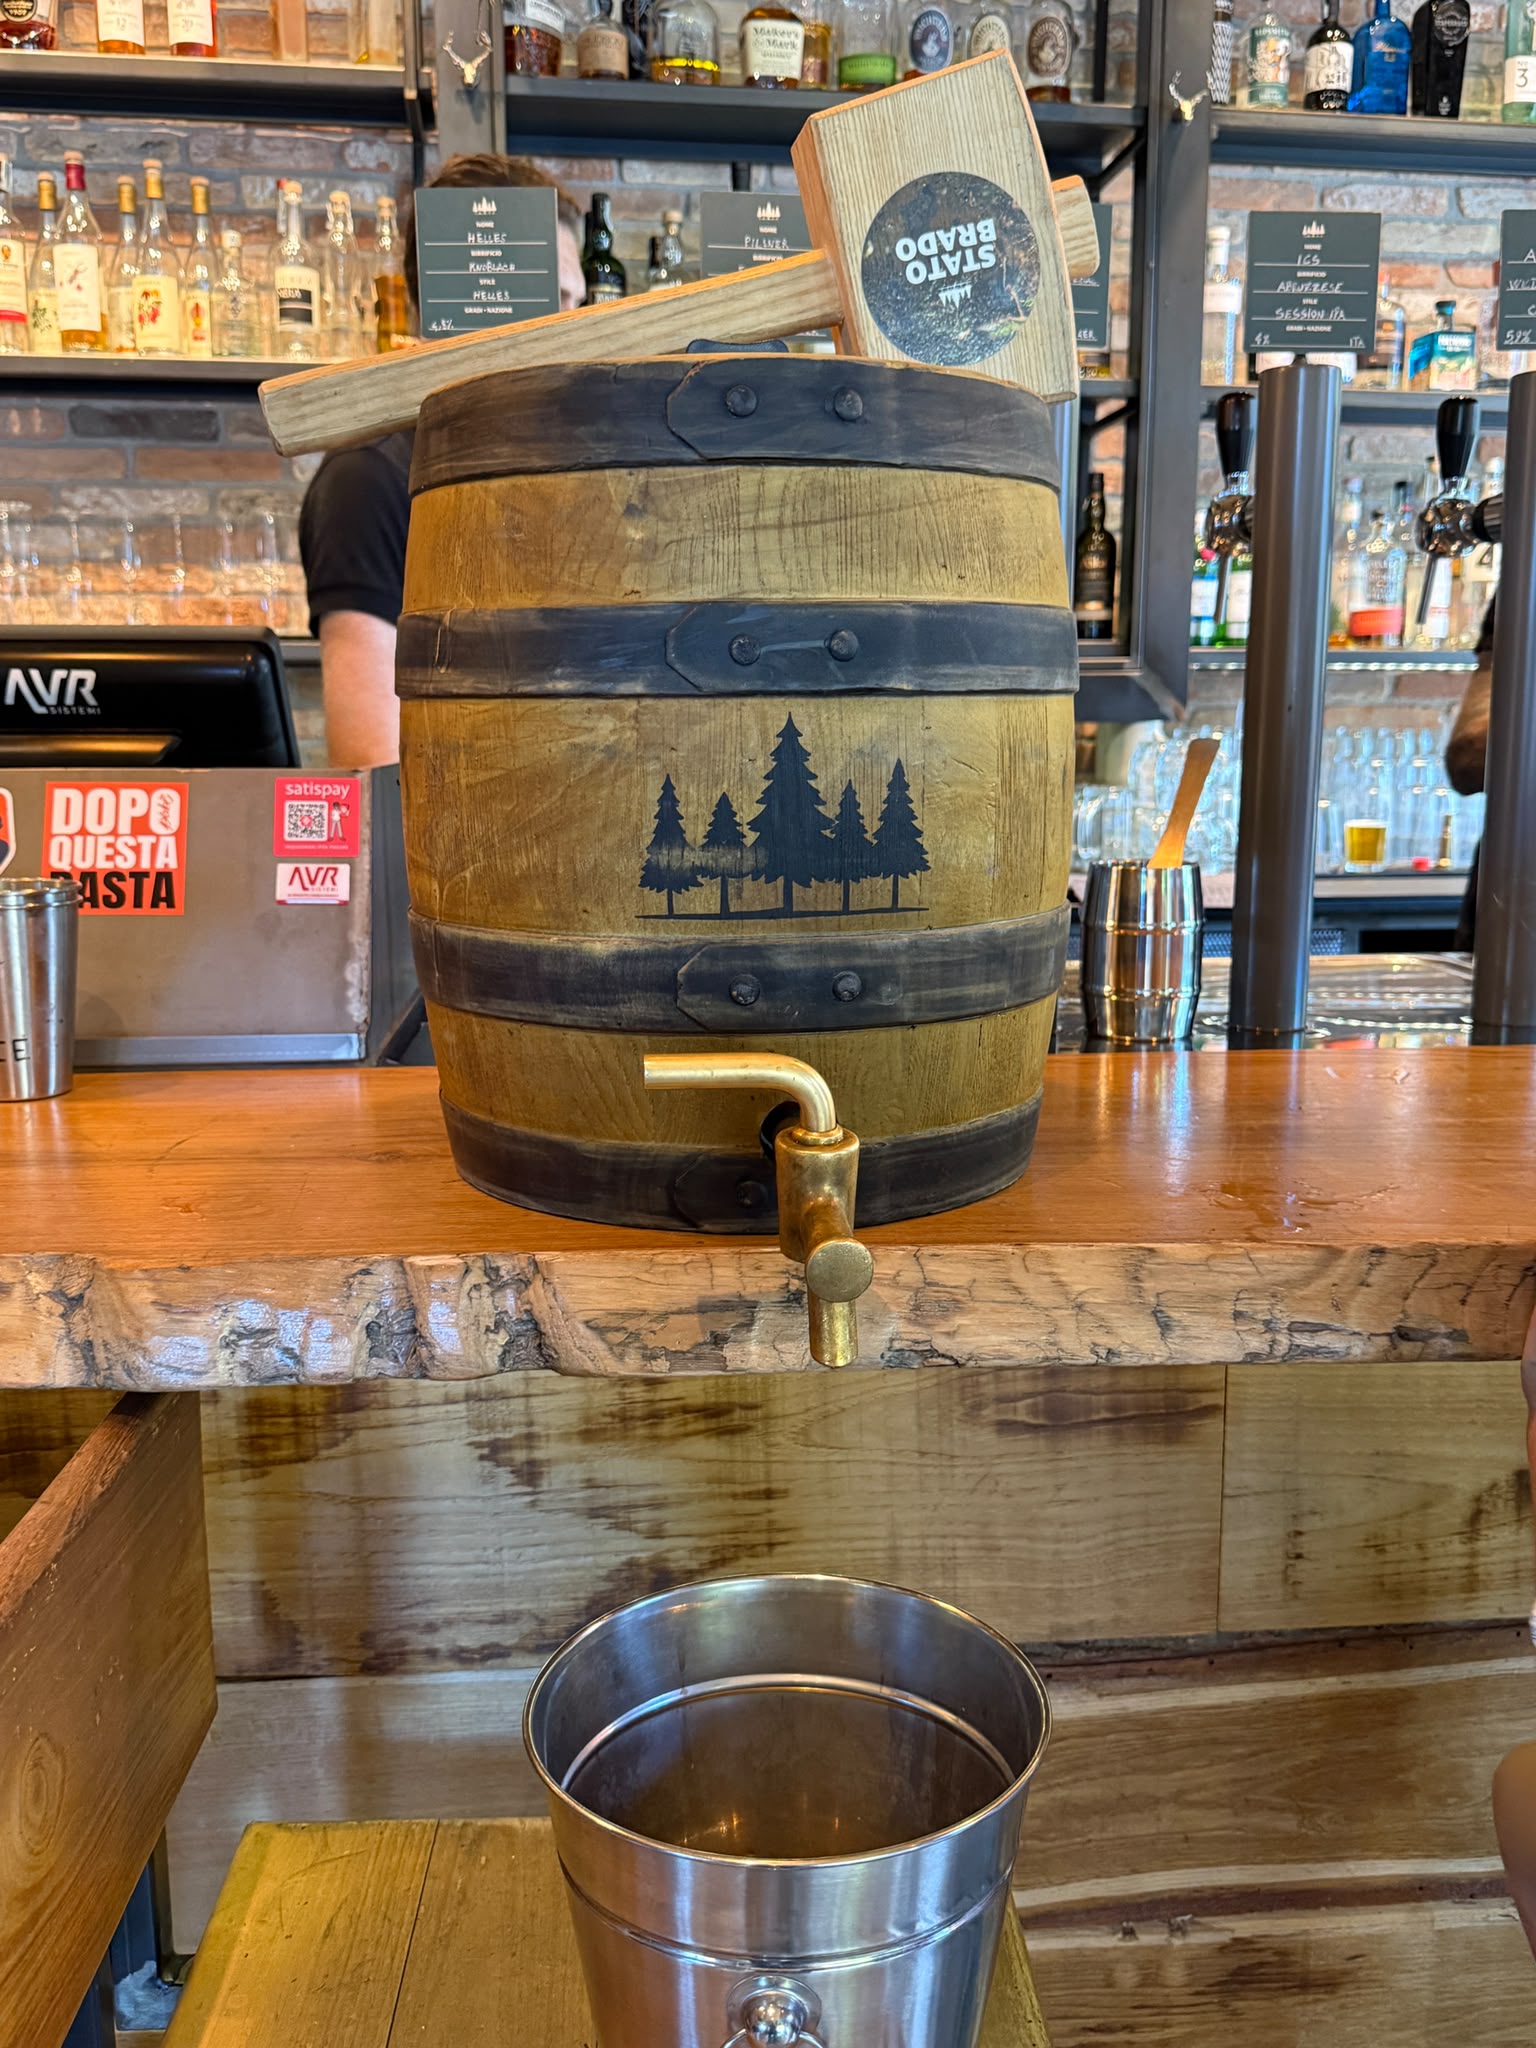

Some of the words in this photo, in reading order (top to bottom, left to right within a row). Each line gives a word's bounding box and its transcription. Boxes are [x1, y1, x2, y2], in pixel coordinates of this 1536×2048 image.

[1516, 68, 1528, 88] 3
[467, 232, 507, 243] HELLES
[744, 235, 790, 250] PILSNER
[895, 218, 997, 262] BRADO
[905, 243, 997, 285] STATO
[472, 290, 511, 301] HELLES
[1274, 307, 1325, 320] SESSION
[1328, 306, 1347, 320] IPA
[4, 667, 98, 714] AVR
[48, 706, 101, 715] SISTEMI
[285, 782, 350, 800] satispay
[51, 788, 181, 835] DOPO
[49, 835, 178, 871] QUESTA
[288, 866, 339, 891] AVR
[50, 871, 176, 909] ASTA
